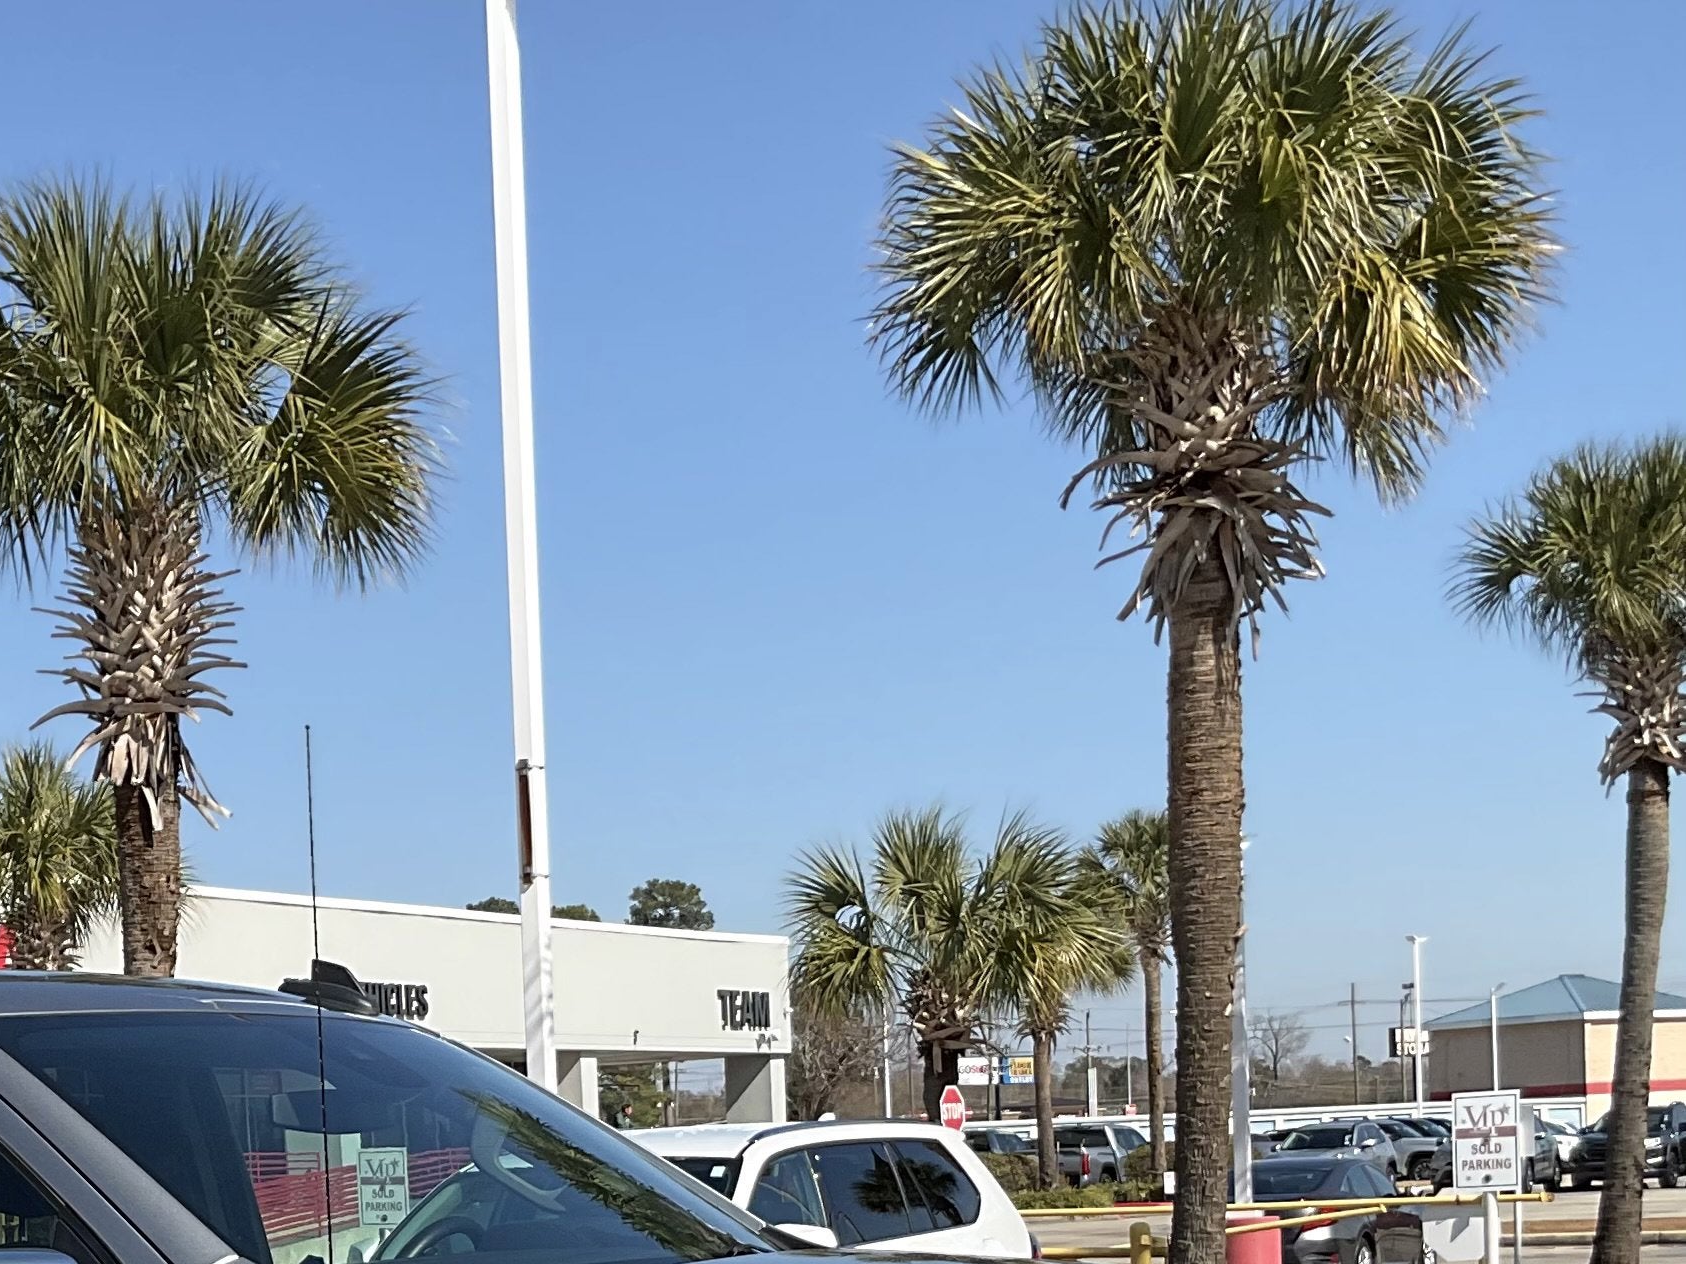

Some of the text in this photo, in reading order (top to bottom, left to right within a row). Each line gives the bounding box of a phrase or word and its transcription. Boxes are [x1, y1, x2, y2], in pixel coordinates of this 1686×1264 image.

[716, 989, 771, 1031] TEAM
[942, 1103, 963, 1120] STOP
[1471, 1142, 1502, 1155] SOLD
[1461, 1158, 1512, 1171] PARKING
[372, 1188, 395, 1199] SOLD
[364, 1201, 403, 1212] PARKING
